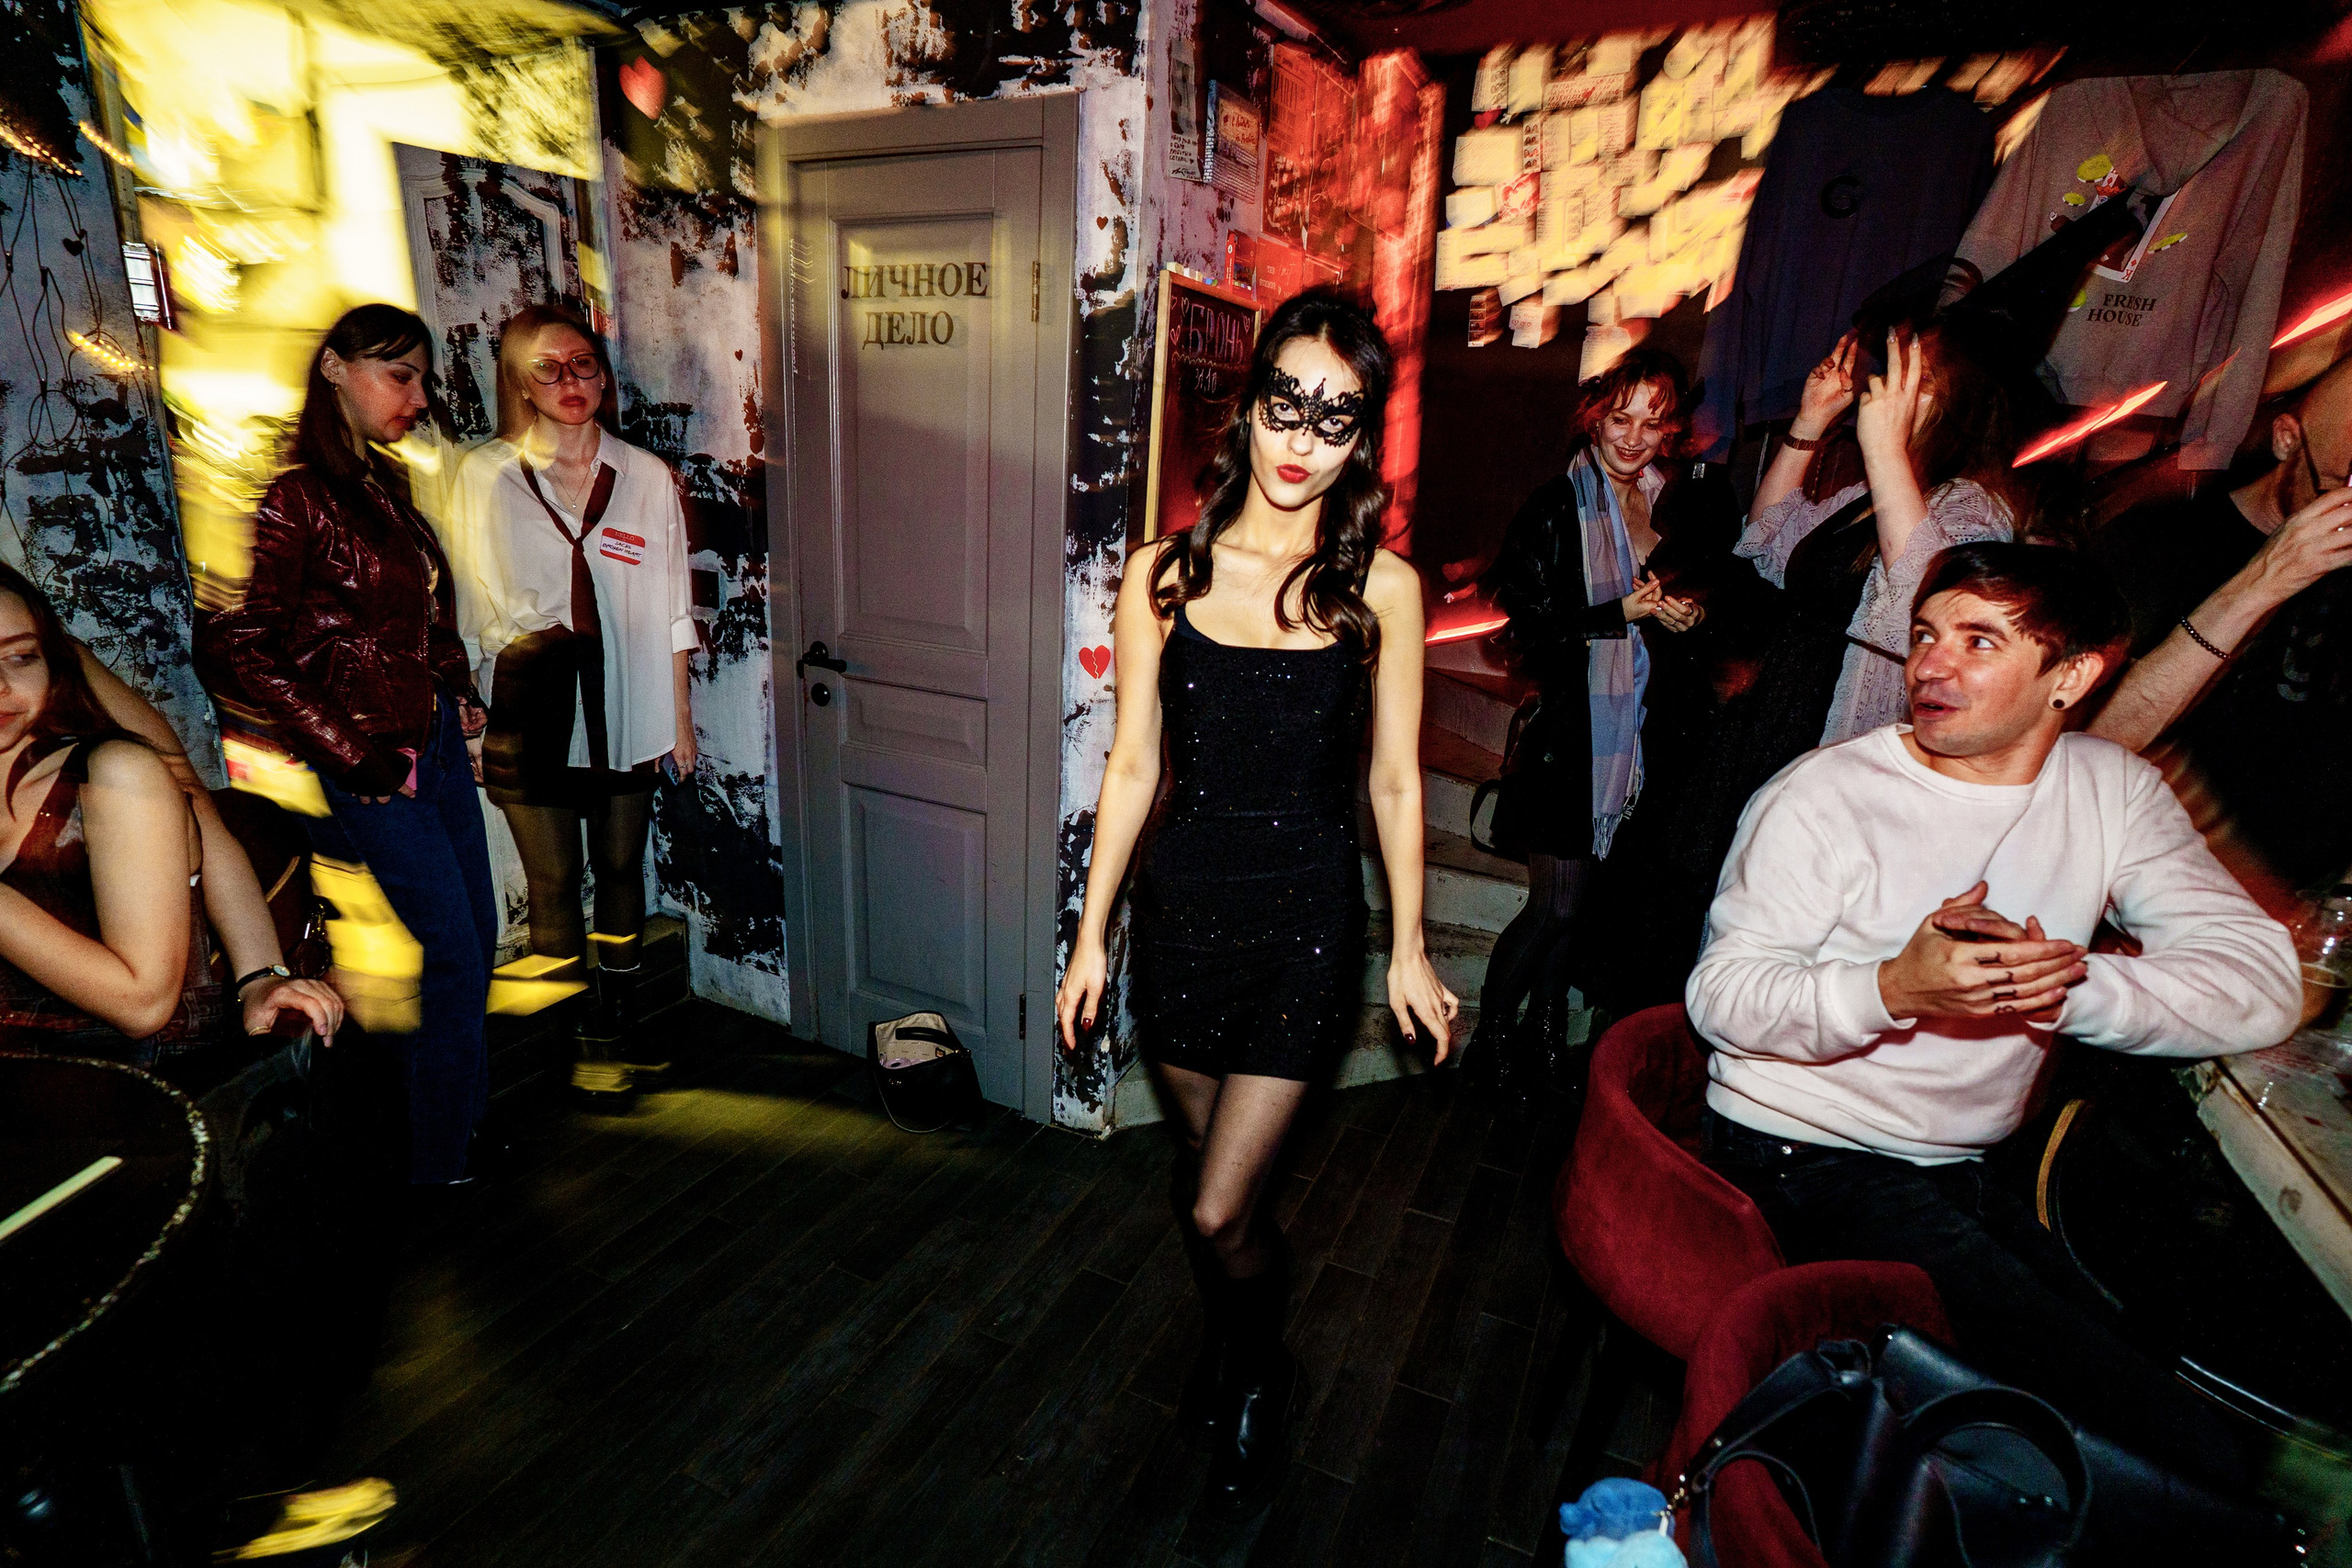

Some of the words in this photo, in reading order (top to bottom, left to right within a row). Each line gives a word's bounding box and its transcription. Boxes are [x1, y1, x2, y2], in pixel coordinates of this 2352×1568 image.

[1818, 175, 1863, 220] G
[841, 262, 989, 300] ЛИЧНОЕ
[2102, 293, 2157, 311] FRESH
[862, 310, 955, 350] ДЕЛО
[2086, 308, 2143, 327] HOUSE
[1188, 302, 1244, 365] БРОНЬ
[602, 543, 624, 551] BROKEN
[615, 531, 635, 541] HELLO
